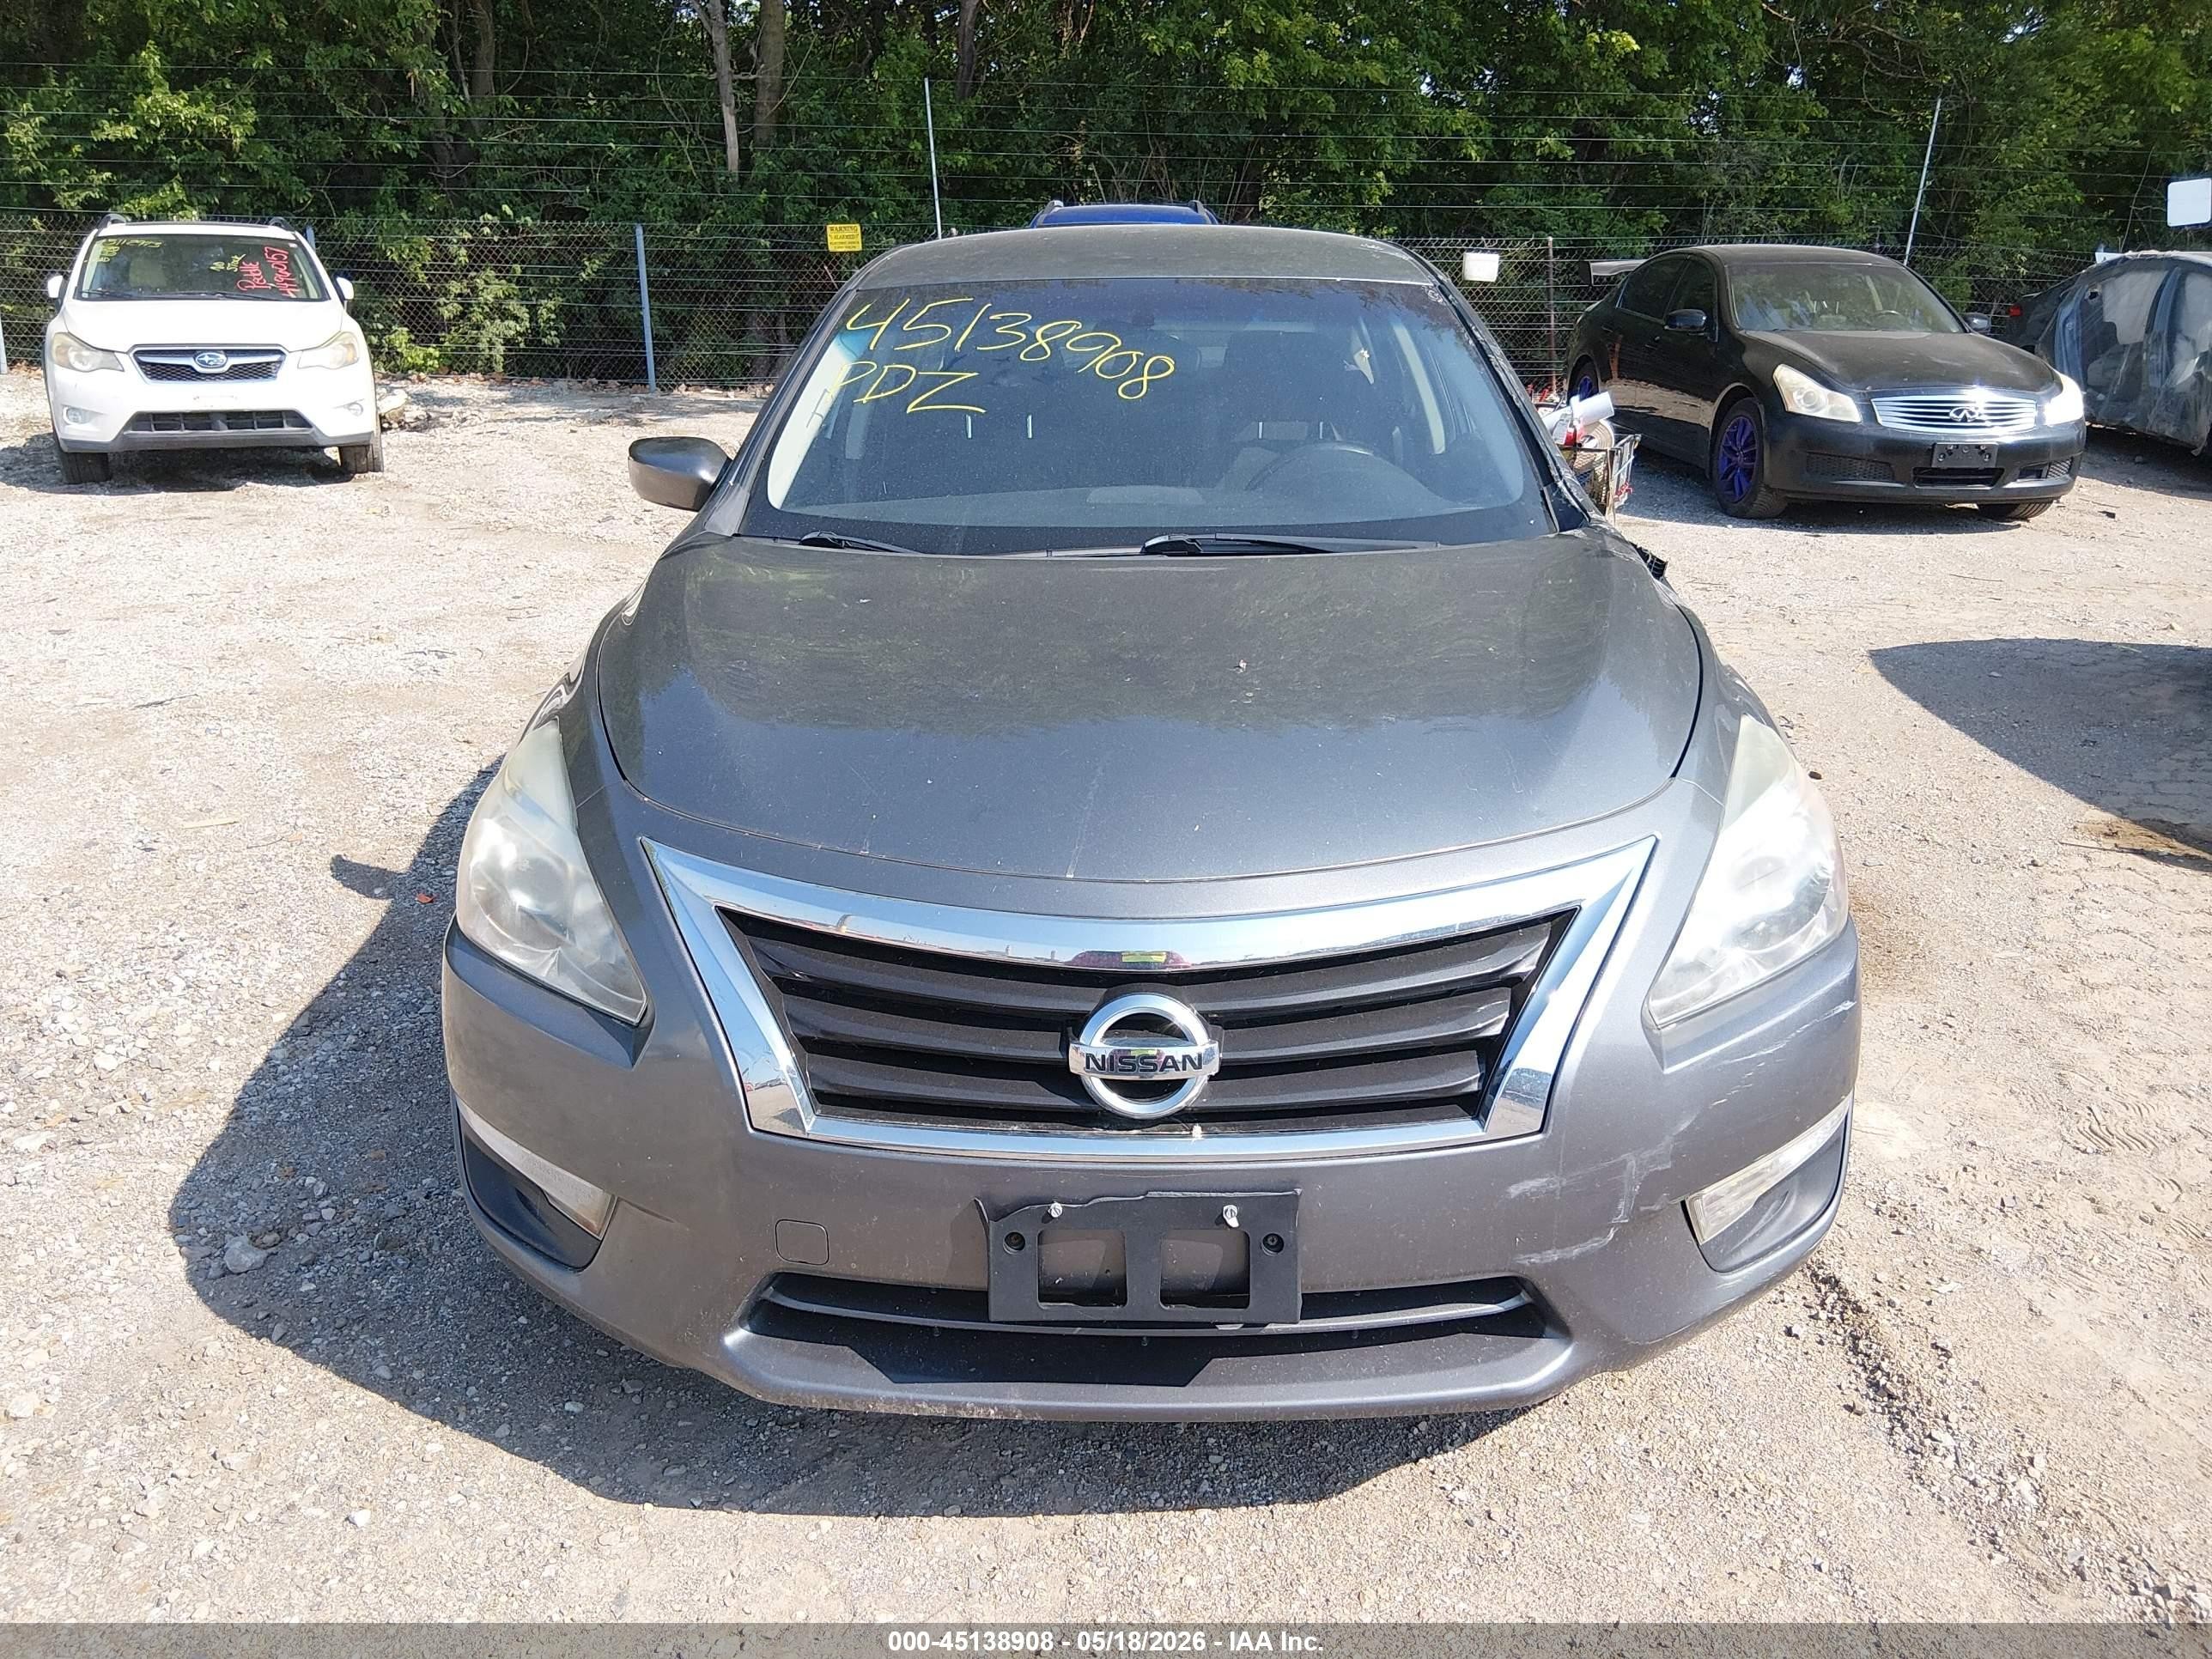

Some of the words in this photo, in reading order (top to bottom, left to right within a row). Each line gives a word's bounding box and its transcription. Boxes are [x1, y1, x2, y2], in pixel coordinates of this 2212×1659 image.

[846, 297, 1176, 399] 45138908
[828, 361, 987, 414] PDZ
[1085, 1053, 1203, 1073] NISSAN
